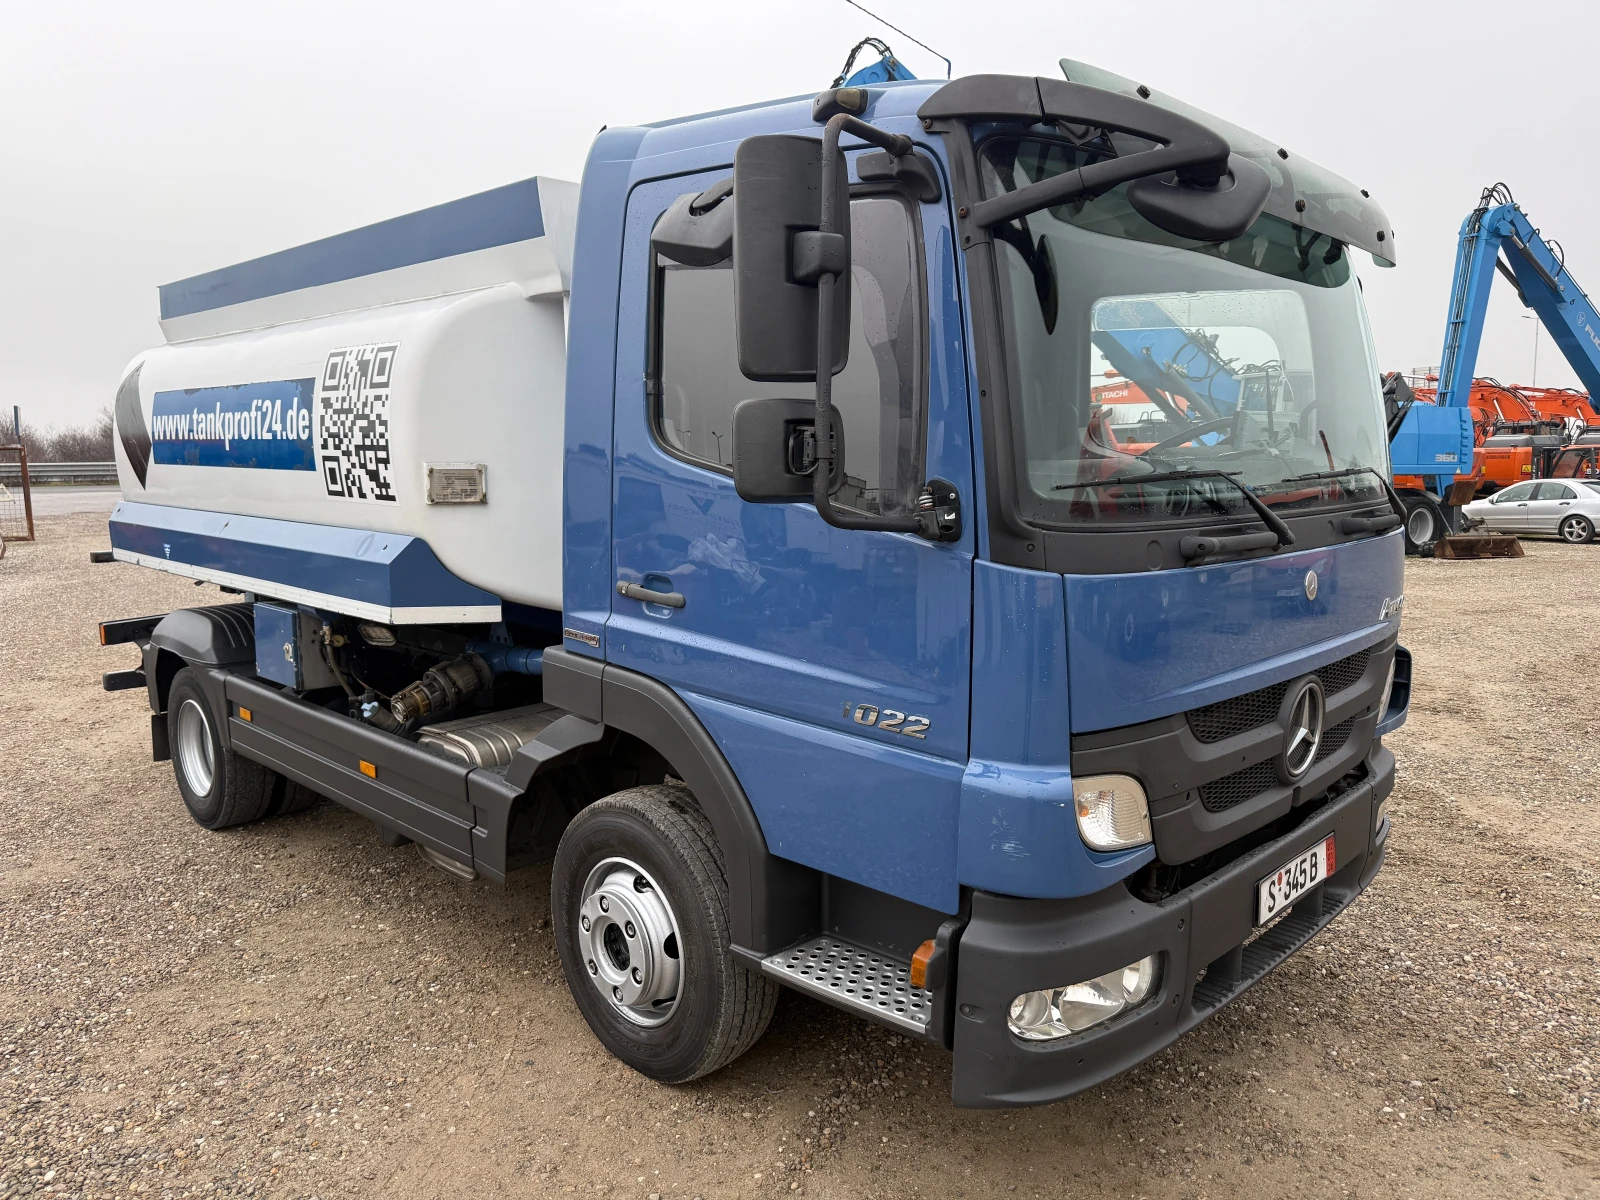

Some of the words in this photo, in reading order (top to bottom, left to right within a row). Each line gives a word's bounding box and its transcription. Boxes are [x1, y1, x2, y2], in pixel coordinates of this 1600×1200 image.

[153, 397, 310, 451] www.tankprofi24.de
[1435, 454, 1458, 462] 360
[842, 701, 930, 739] 1022
